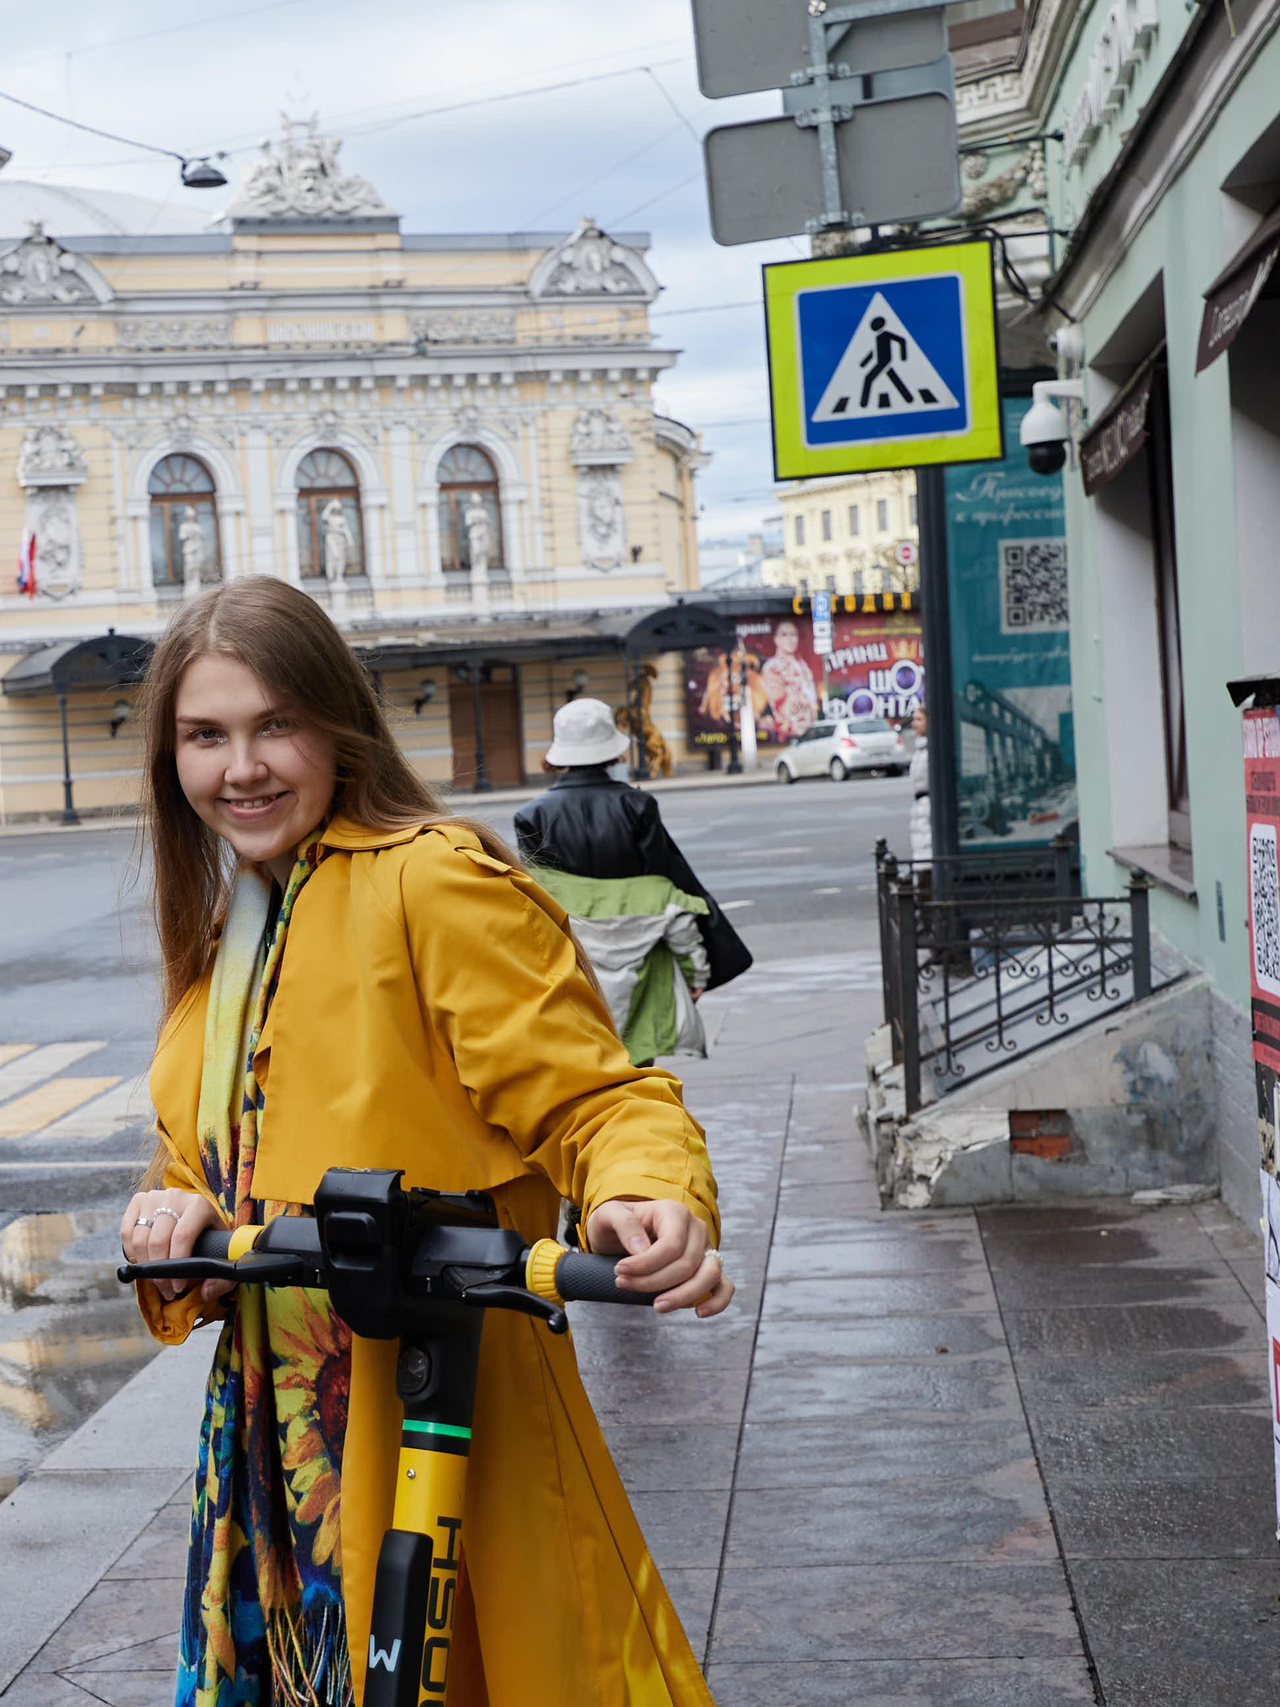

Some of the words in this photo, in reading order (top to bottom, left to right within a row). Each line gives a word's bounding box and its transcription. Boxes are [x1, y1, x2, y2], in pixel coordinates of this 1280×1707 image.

[792, 591, 912, 615] СГОДНЯ
[868, 659, 924, 696] ШО
[822, 687, 922, 720] ФОНТА
[419, 1516, 462, 1707] OSH
[368, 1633, 402, 1673] W
